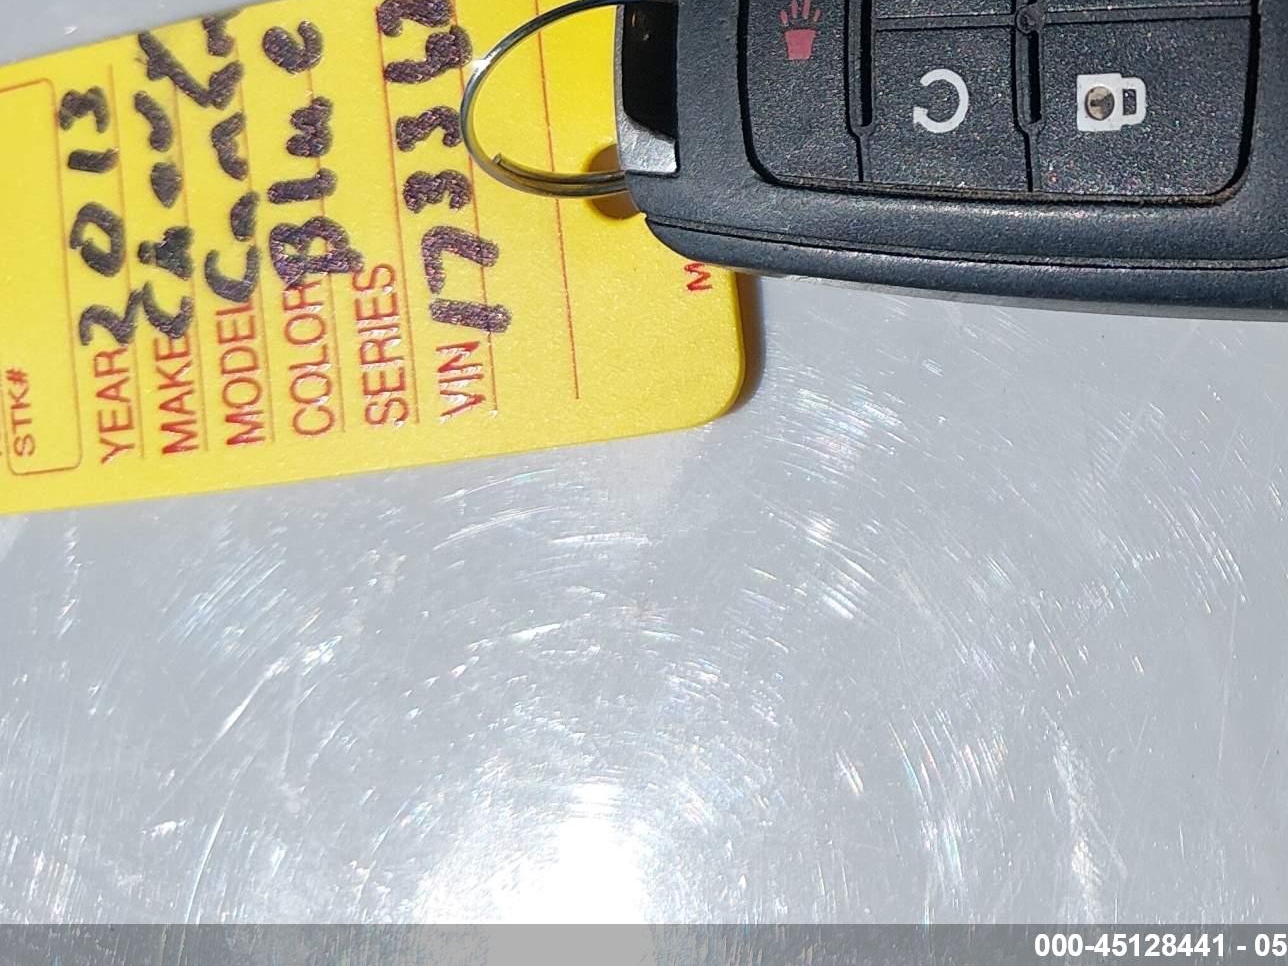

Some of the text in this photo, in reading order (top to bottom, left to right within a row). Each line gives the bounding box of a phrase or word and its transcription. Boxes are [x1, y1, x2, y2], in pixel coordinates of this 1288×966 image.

[58, 86, 143, 345] 2013
[262, 19, 364, 288] Blue
[6, 367, 36, 457] STK#
[96, 343, 136, 464] YEAR
[153, 333, 200, 455] MAKE
[215, 295, 266, 446] MODEL
[282, 280, 336, 436] COLOR
[351, 263, 409, 426] SERIES
[435, 340, 486, 419] VIN
